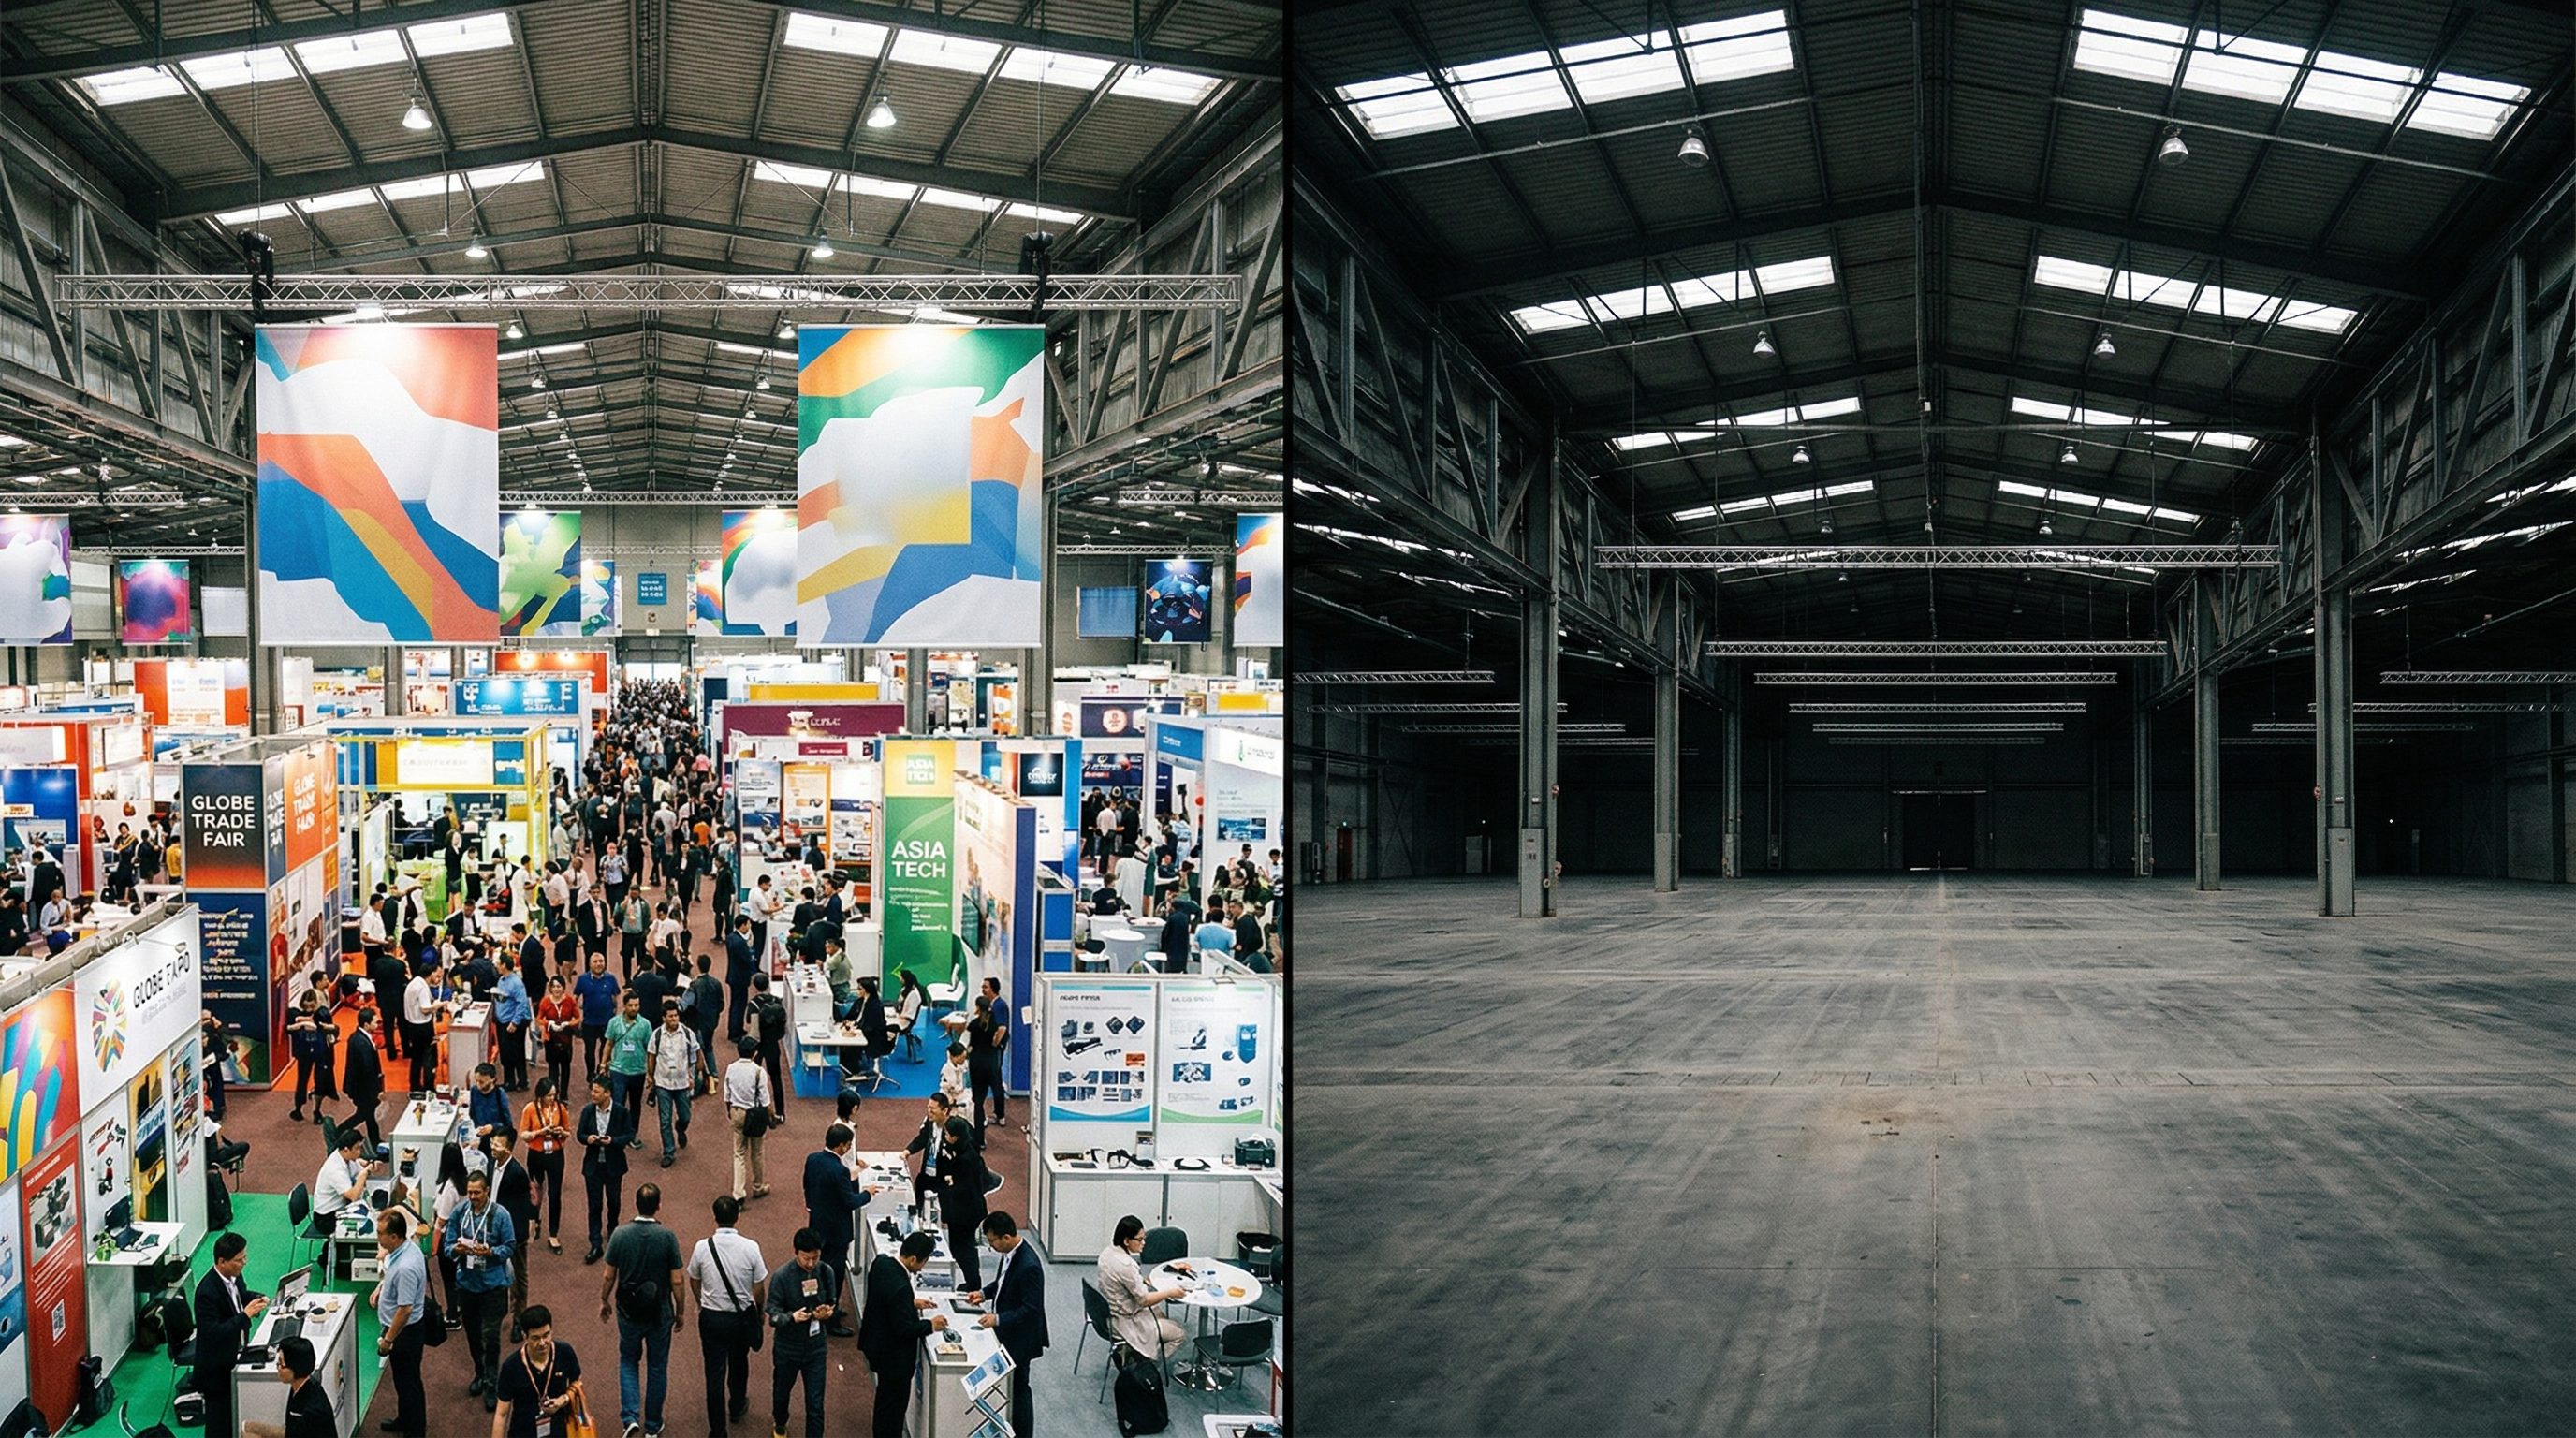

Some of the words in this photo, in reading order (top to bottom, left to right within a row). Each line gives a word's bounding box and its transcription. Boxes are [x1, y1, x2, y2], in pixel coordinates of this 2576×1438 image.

[191, 795, 256, 811] GLOBE
[191, 814, 256, 829] TRADE
[202, 831, 245, 847] FAIR
[891, 841, 947, 859] ASIA
[891, 861, 946, 879] TECH
[133, 968, 164, 1009] GLOBE
